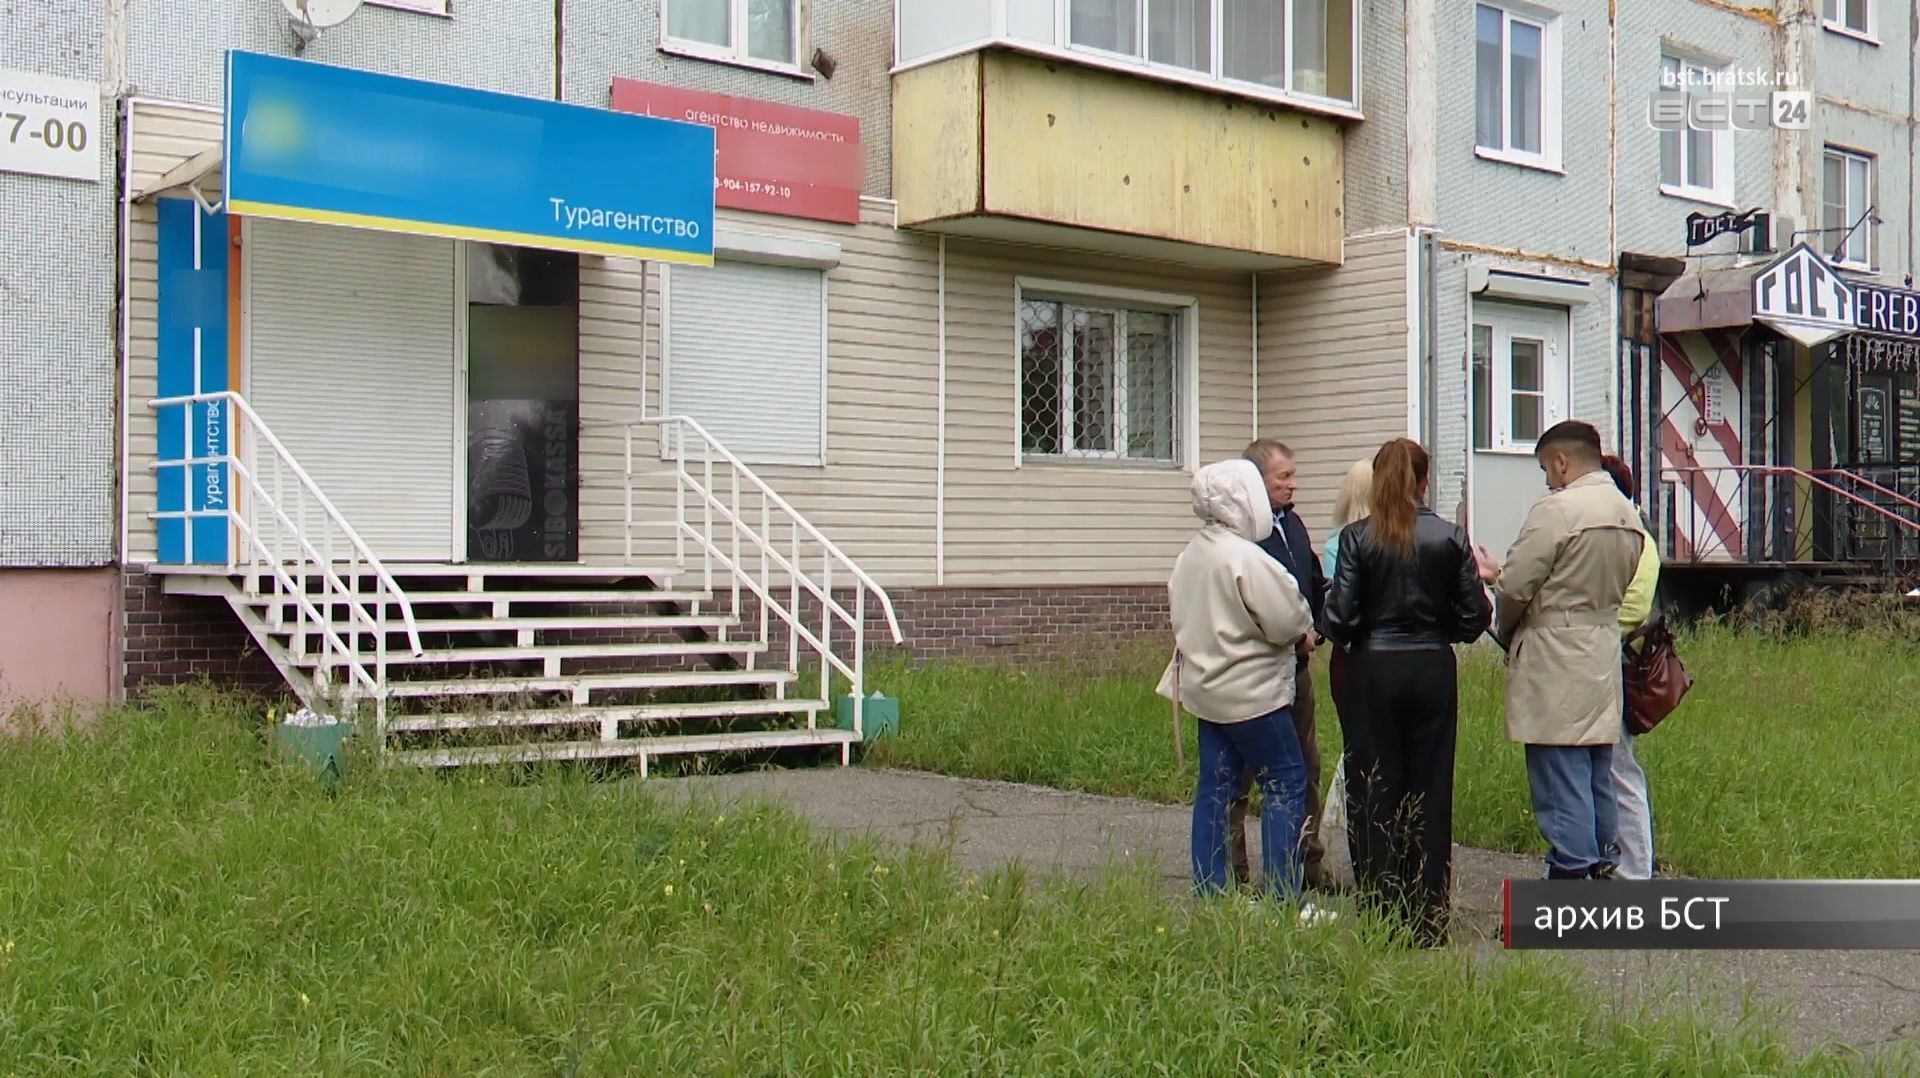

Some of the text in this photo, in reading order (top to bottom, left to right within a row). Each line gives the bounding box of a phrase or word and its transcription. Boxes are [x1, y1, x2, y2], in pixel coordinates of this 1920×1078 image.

[0, 112, 87, 152] 7-00
[685, 108, 749, 129] агентство
[549, 197, 700, 239] Турагентство
[1692, 214, 1738, 241] ГОСТ
